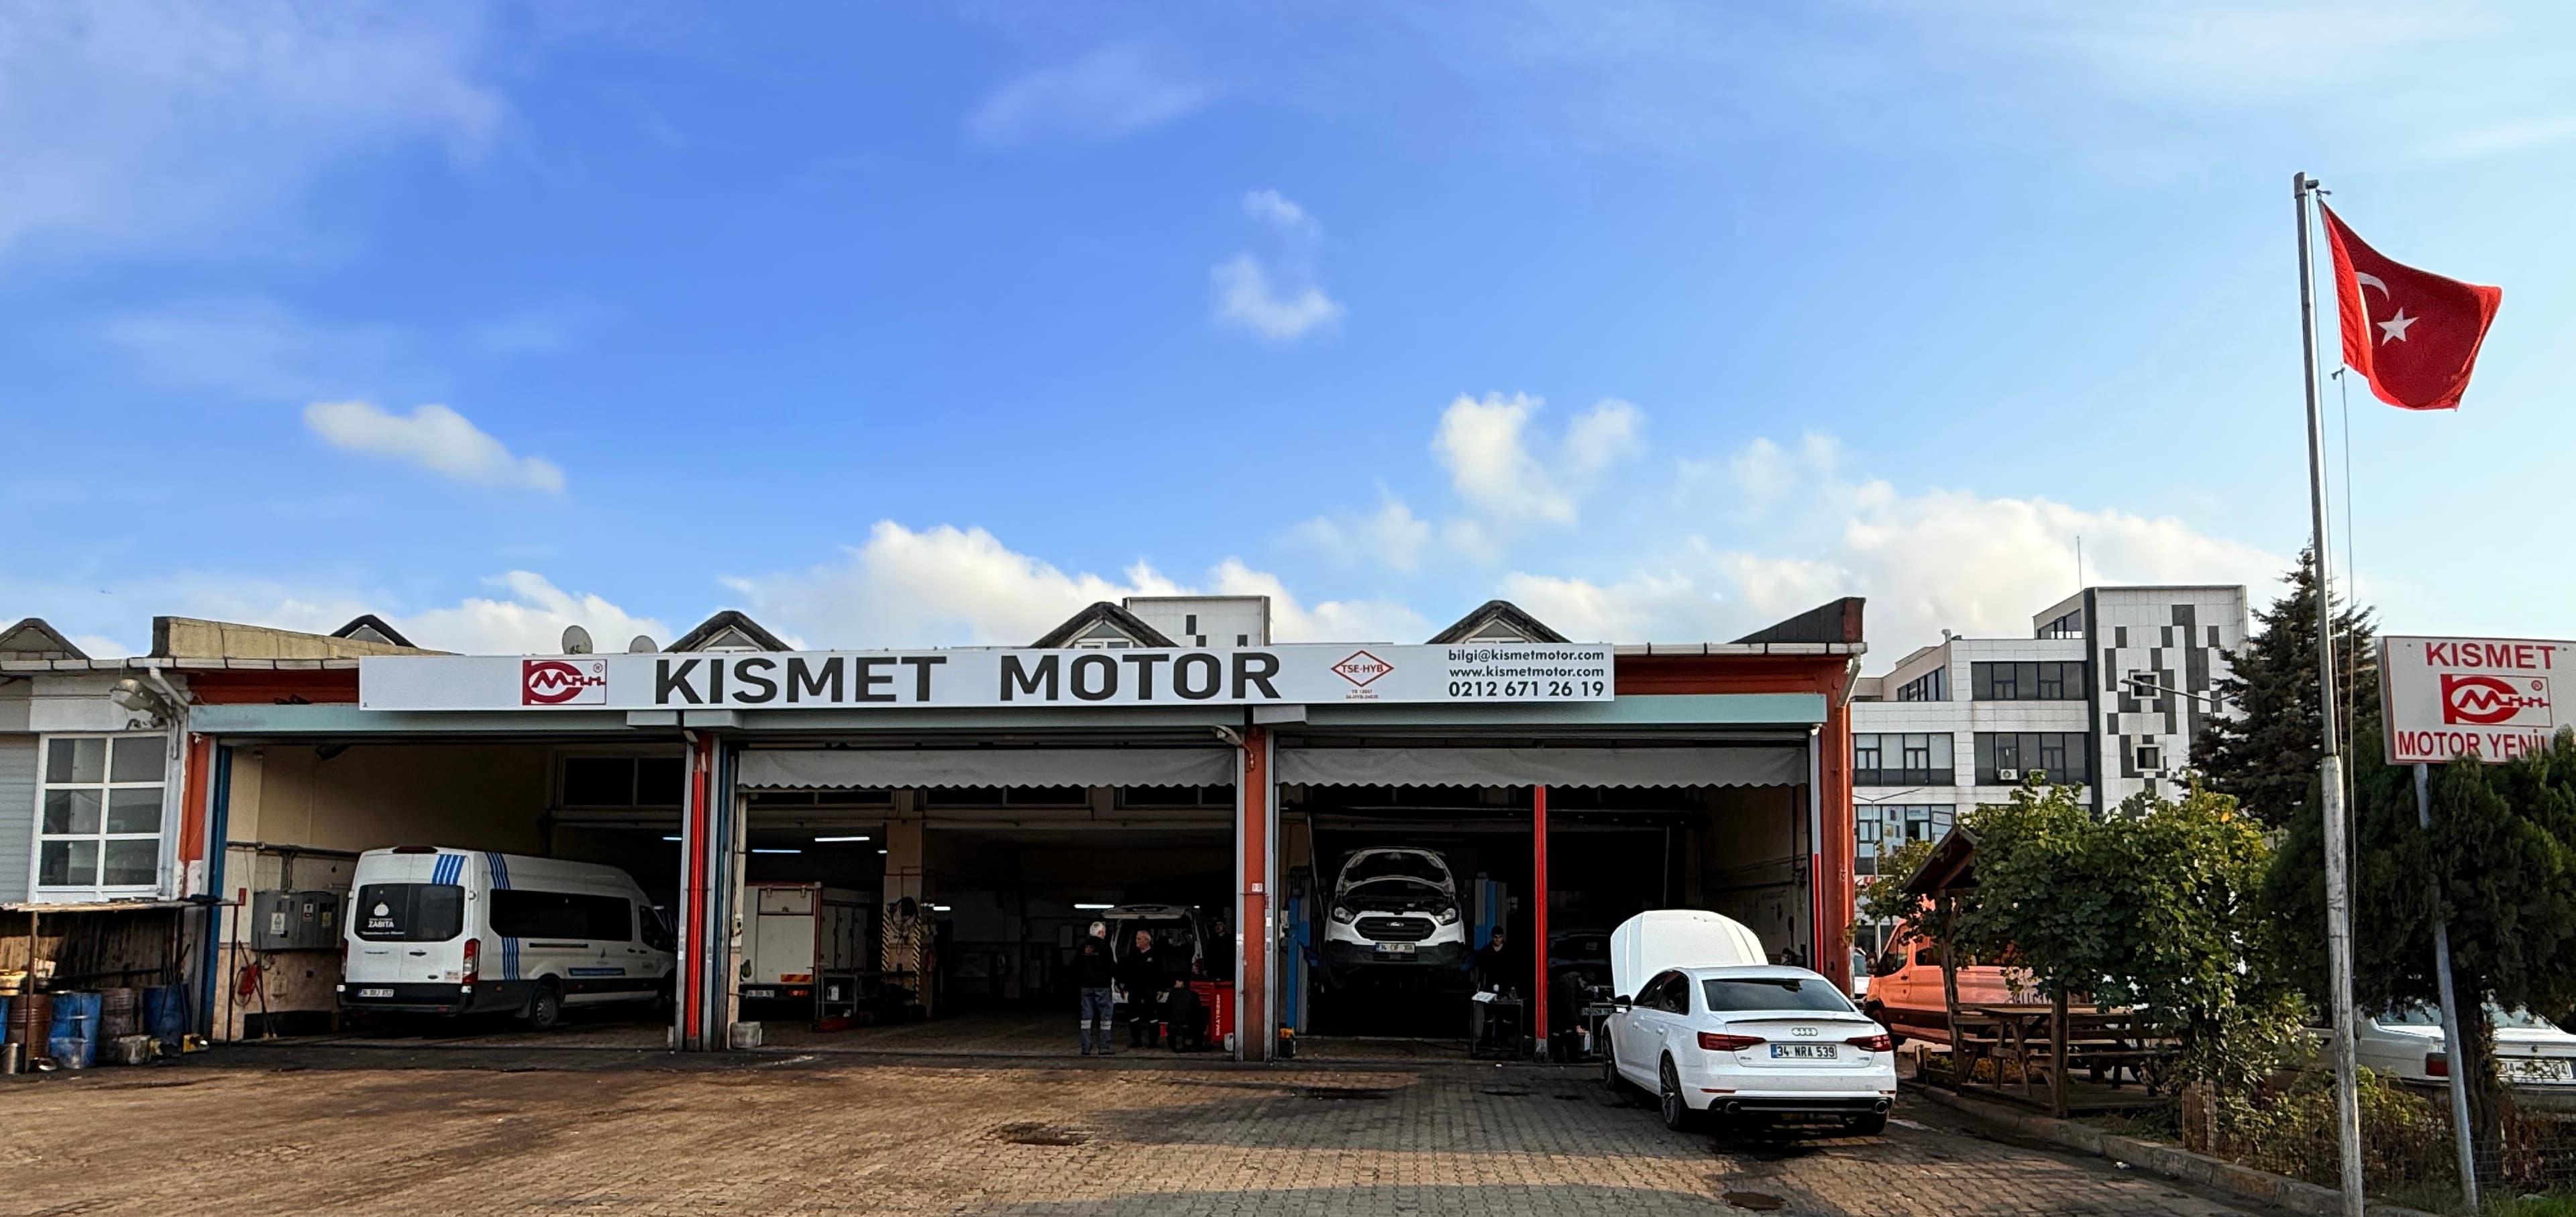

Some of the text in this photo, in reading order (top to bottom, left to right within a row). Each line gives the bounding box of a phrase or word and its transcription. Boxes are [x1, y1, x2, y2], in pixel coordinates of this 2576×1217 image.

[1448, 649, 1604, 663] bilgi@kismetmotor.com
[2426, 642, 2556, 670] KISMET
[1342, 664, 1383, 673] TSE-HYB
[1450, 666, 1604, 677] www.kismetmotor.com
[655, 653, 1281, 704] KISMET MOTOR
[1449, 681, 1604, 696] 0212 671 26 19
[2398, 731, 2482, 757] MOTOR
[1777, 1046, 1835, 1057] 34 NRA 539
